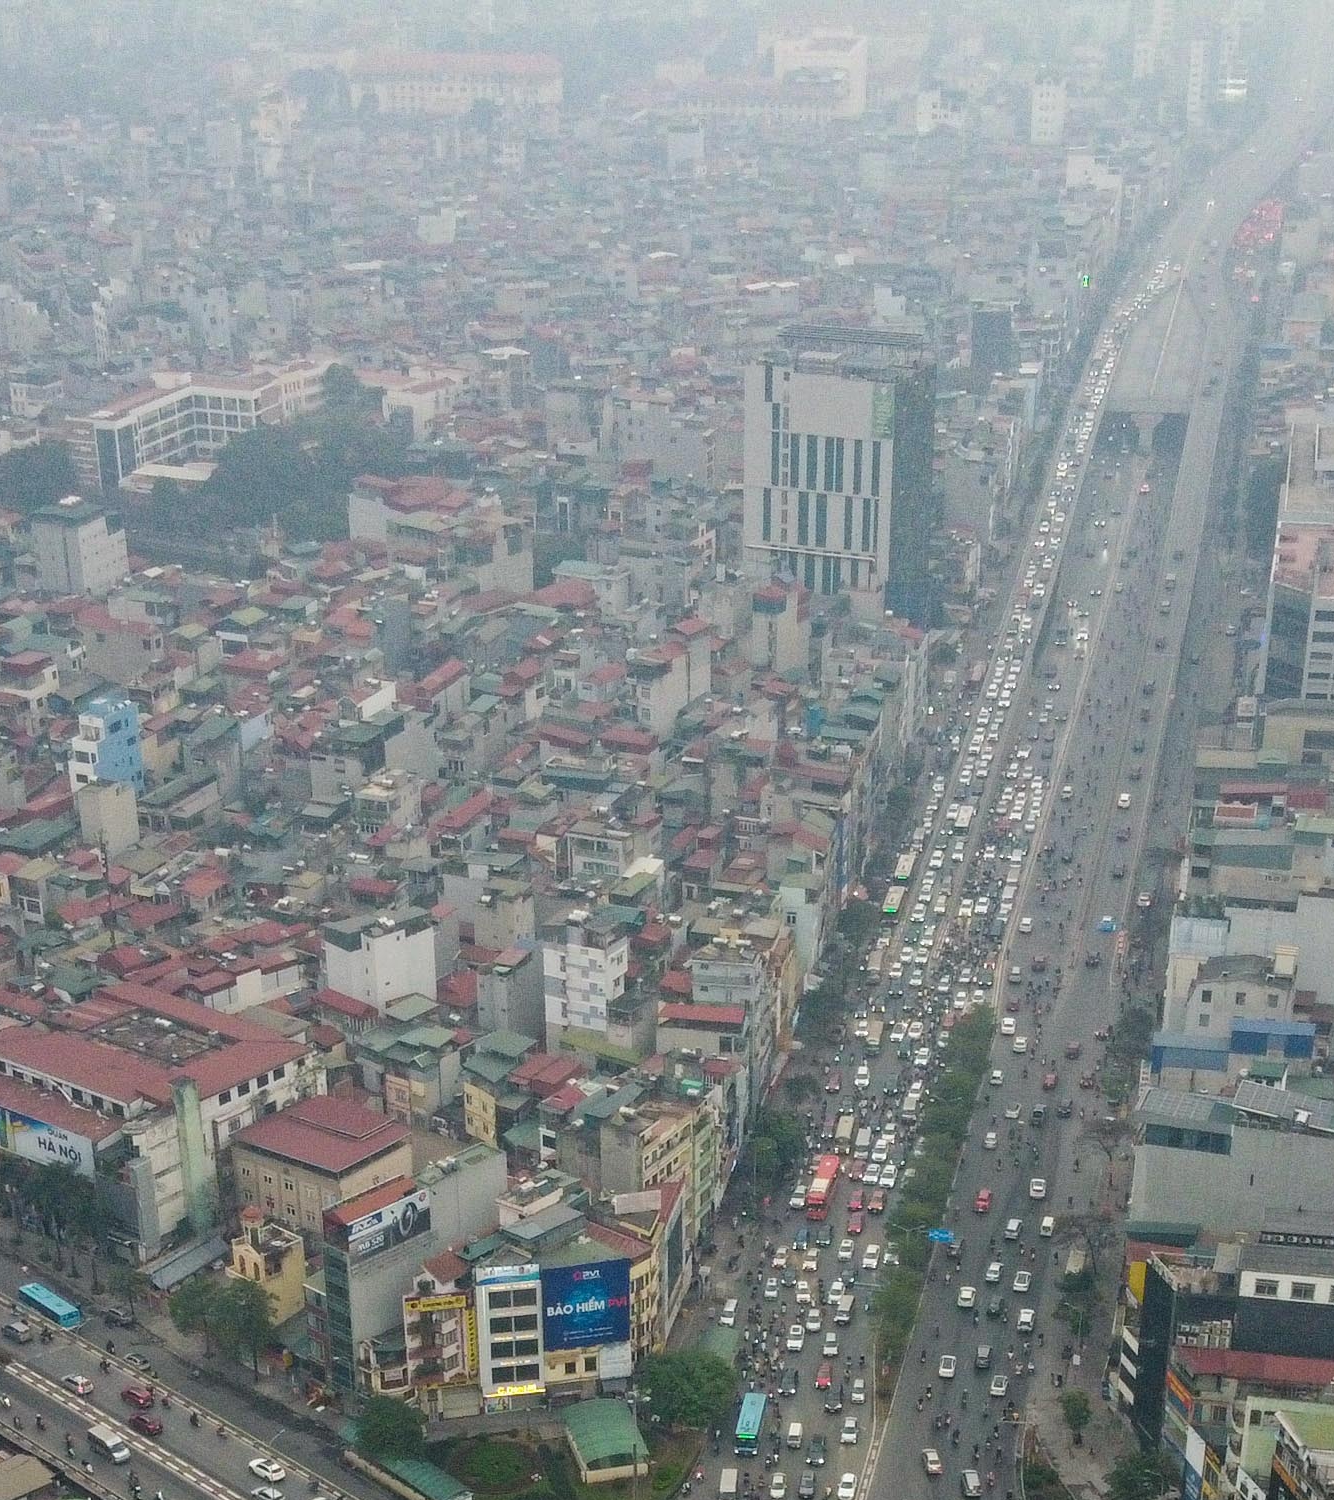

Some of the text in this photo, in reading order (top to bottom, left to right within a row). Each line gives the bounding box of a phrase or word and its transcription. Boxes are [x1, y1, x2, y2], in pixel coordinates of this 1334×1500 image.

[582, 1269, 601, 1279] PVI
[546, 1296, 627, 1317] BẢO HIỂM PVI
